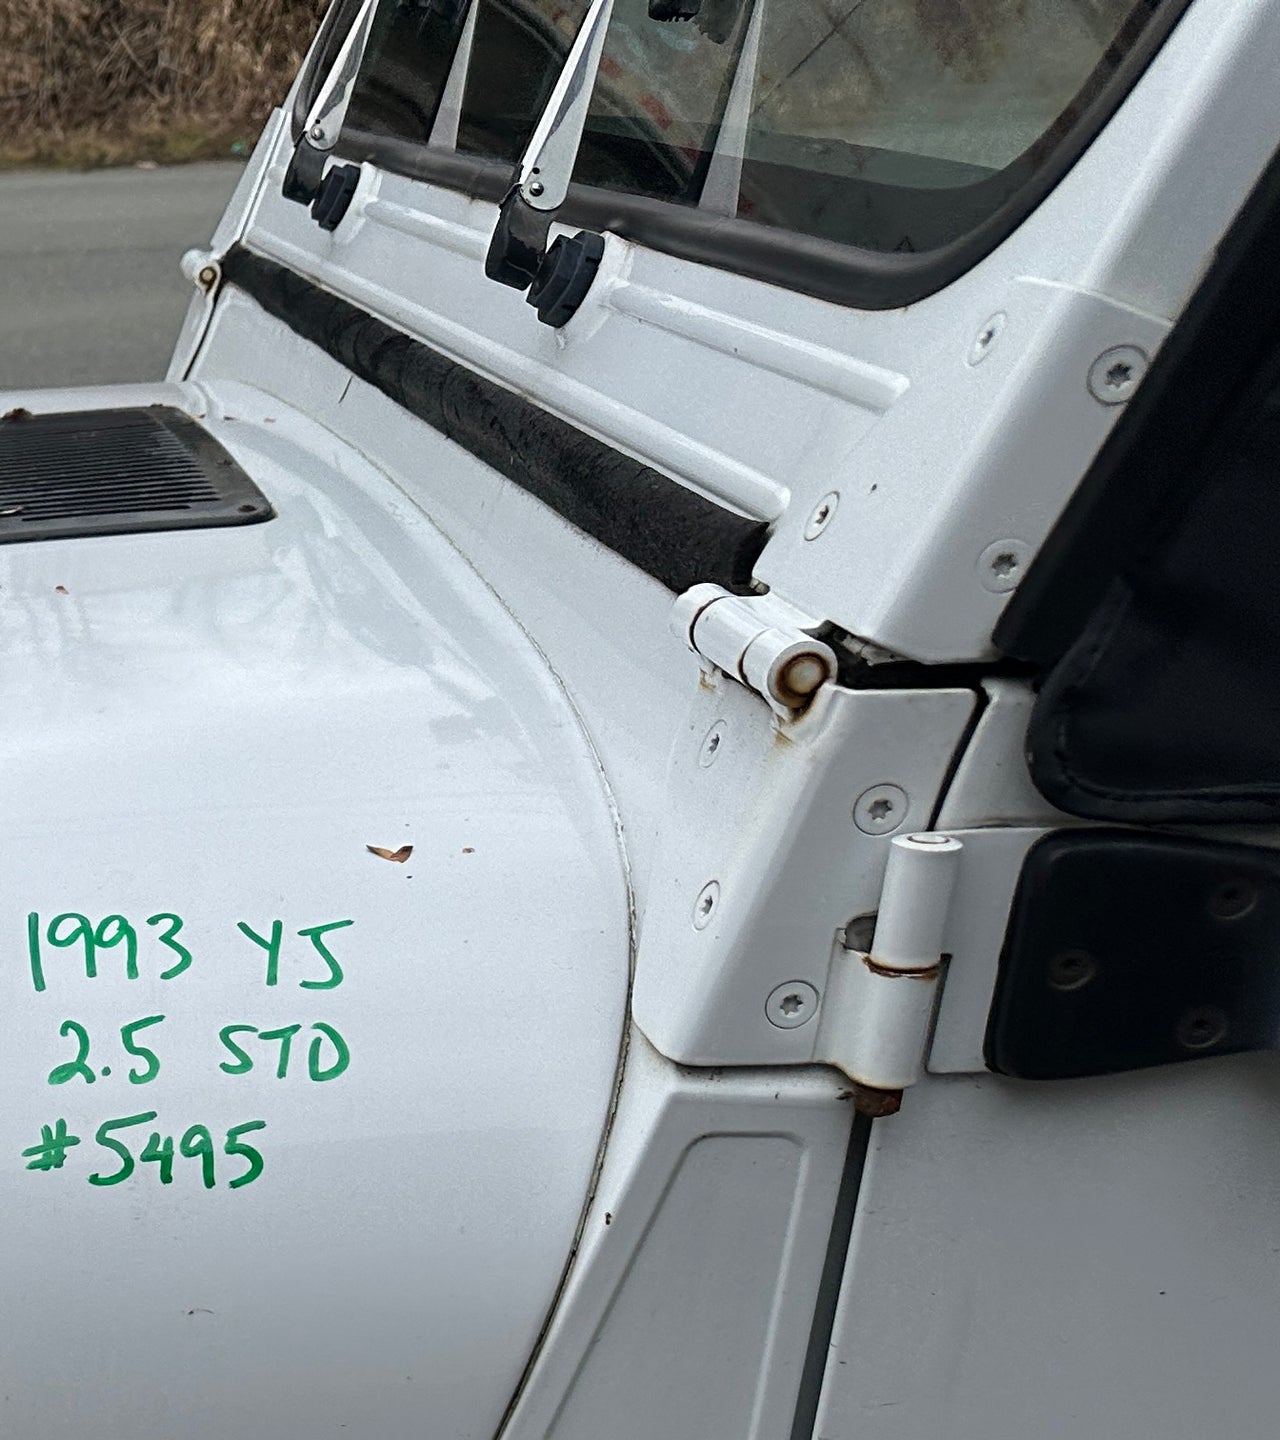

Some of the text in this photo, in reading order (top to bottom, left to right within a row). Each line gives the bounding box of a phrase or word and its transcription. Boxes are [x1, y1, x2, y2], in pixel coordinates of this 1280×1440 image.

[27, 911, 355, 992] 1993 YJ
[47, 1014, 351, 1086] 2.5 STD
[21, 1110, 267, 1190] #5495
